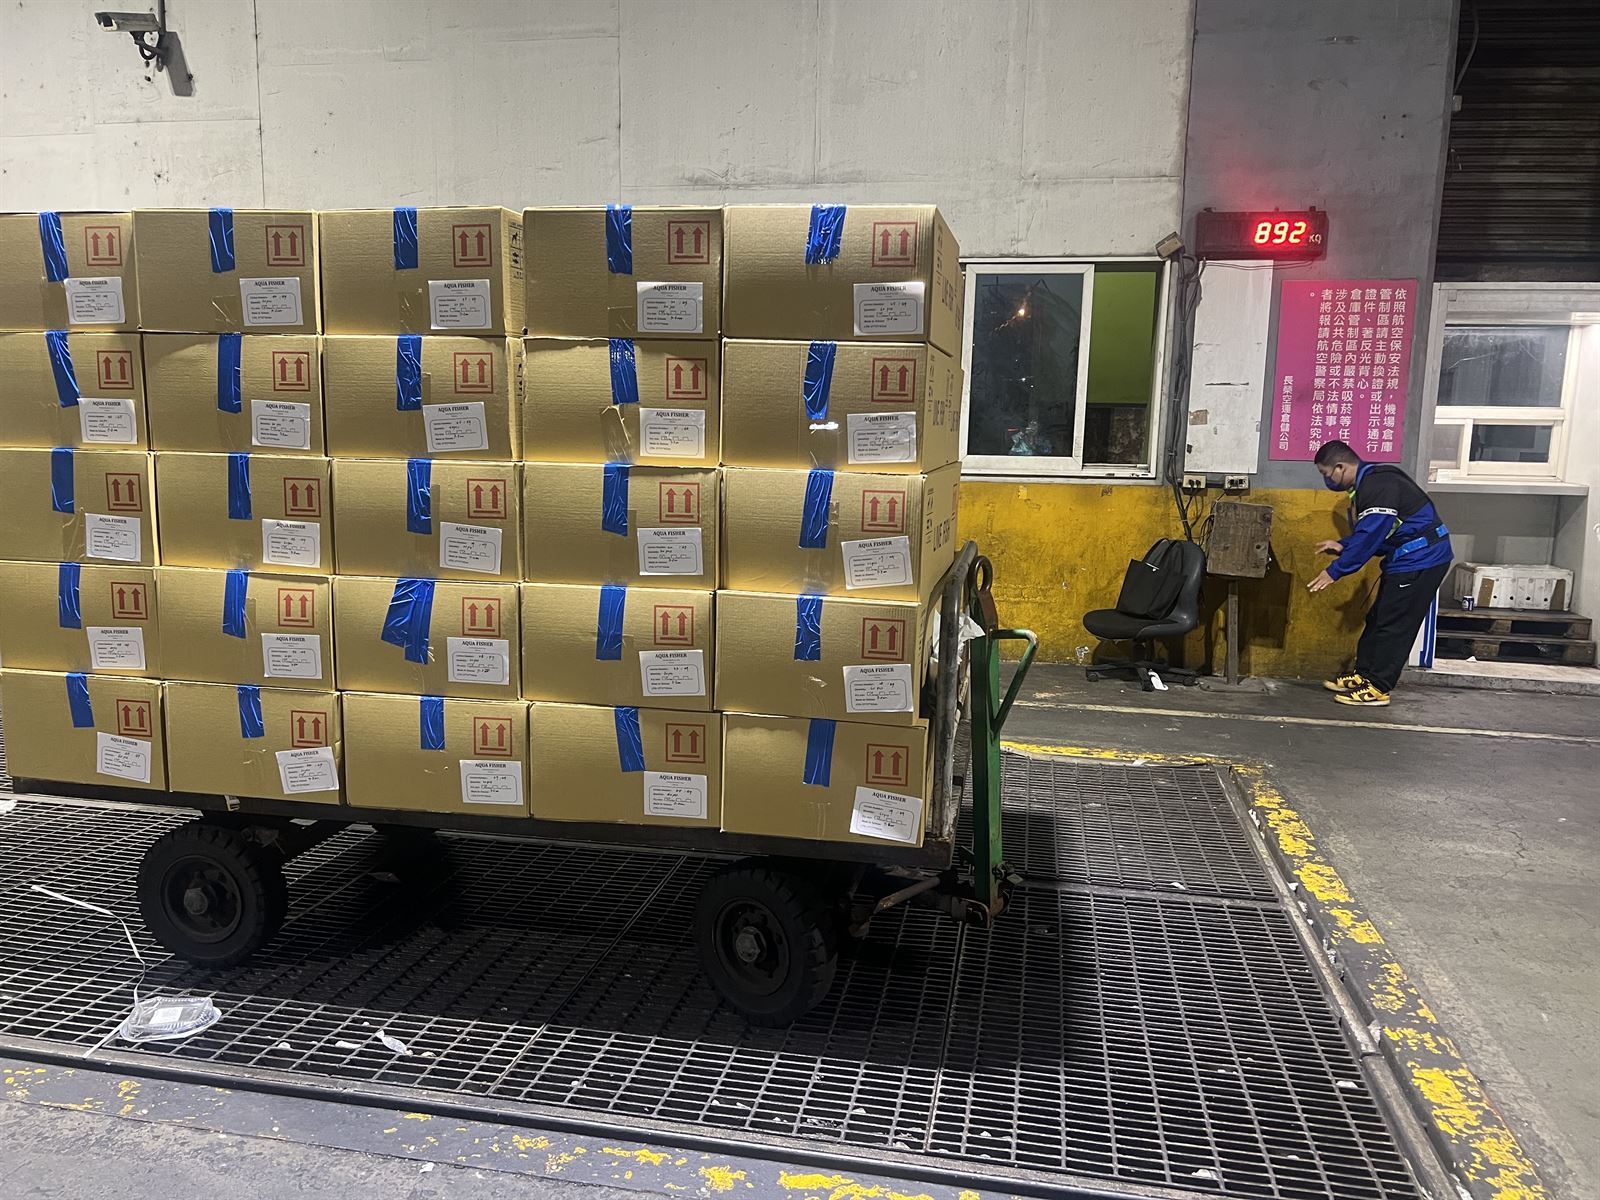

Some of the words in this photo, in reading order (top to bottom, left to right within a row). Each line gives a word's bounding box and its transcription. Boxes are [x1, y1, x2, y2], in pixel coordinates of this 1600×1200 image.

[1254, 221, 1307, 244] 892
[1279, 376, 1294, 451] 長榮空運倉儲公司
[1323, 289, 1348, 444] 涉及公共危險或不法情事，
[1338, 288, 1362, 446] 倉庫管制區內嚴禁吸菸等任
